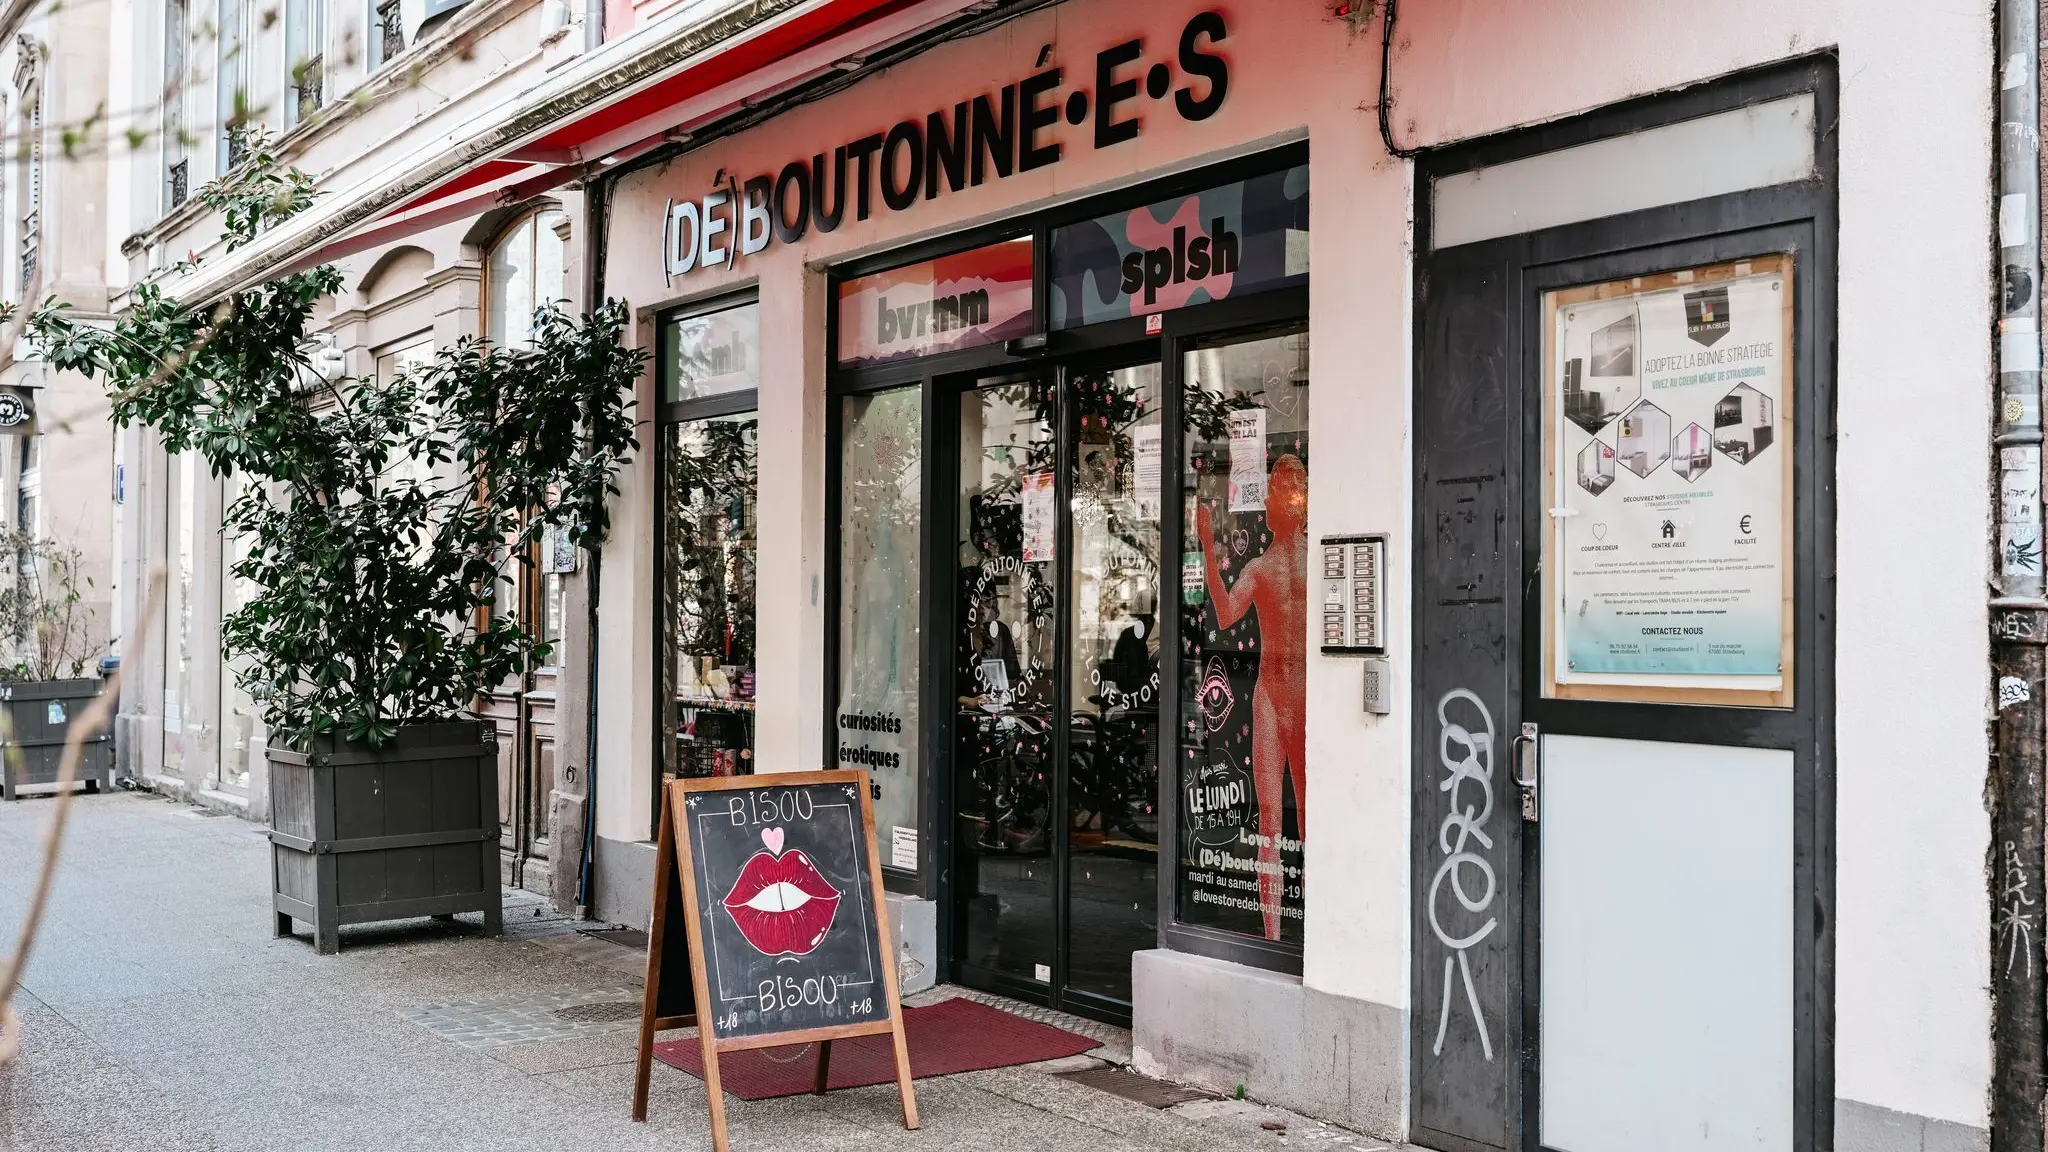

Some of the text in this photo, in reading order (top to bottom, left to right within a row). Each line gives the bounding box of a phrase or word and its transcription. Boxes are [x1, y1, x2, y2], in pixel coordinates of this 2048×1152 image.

[1120, 215, 1239, 306] splsh
[876, 284, 990, 346] bvrmm
[1645, 355, 1682, 373] ADOPTEZ
[1684, 354, 1695, 369] LA
[1697, 349, 1725, 367] BONNE
[1652, 378, 1669, 390] VIVEZ
[1669, 377, 1678, 388] AU
[1679, 375, 1698, 387] COEUR
[1718, 371, 1725, 382] DE
[1726, 365, 1766, 380] STRASBOURG
[1623, 494, 1655, 503] DÉCOUVREZ
[1734, 537, 1757, 545] FACILITÉ
[1641, 627, 1704, 635] CONTACTEZ NOUS
[1085, 655, 1117, 705] LOVE
[839, 709, 902, 734] curiosités
[839, 742, 900, 771] érotiques
[1189, 780, 1246, 814] LE LUNDI
[1194, 810, 1241, 830] DE 15 À 19H
[1240, 827, 1271, 848] Love
[1188, 870, 1214, 885] mardi
[1216, 876, 1227, 887] au
[1228, 877, 1262, 892] samedi
[1192, 888, 1305, 920] @lovestoredeboutonnee
[850, 997, 873, 1016] +18
[717, 1011, 739, 1030] +18
